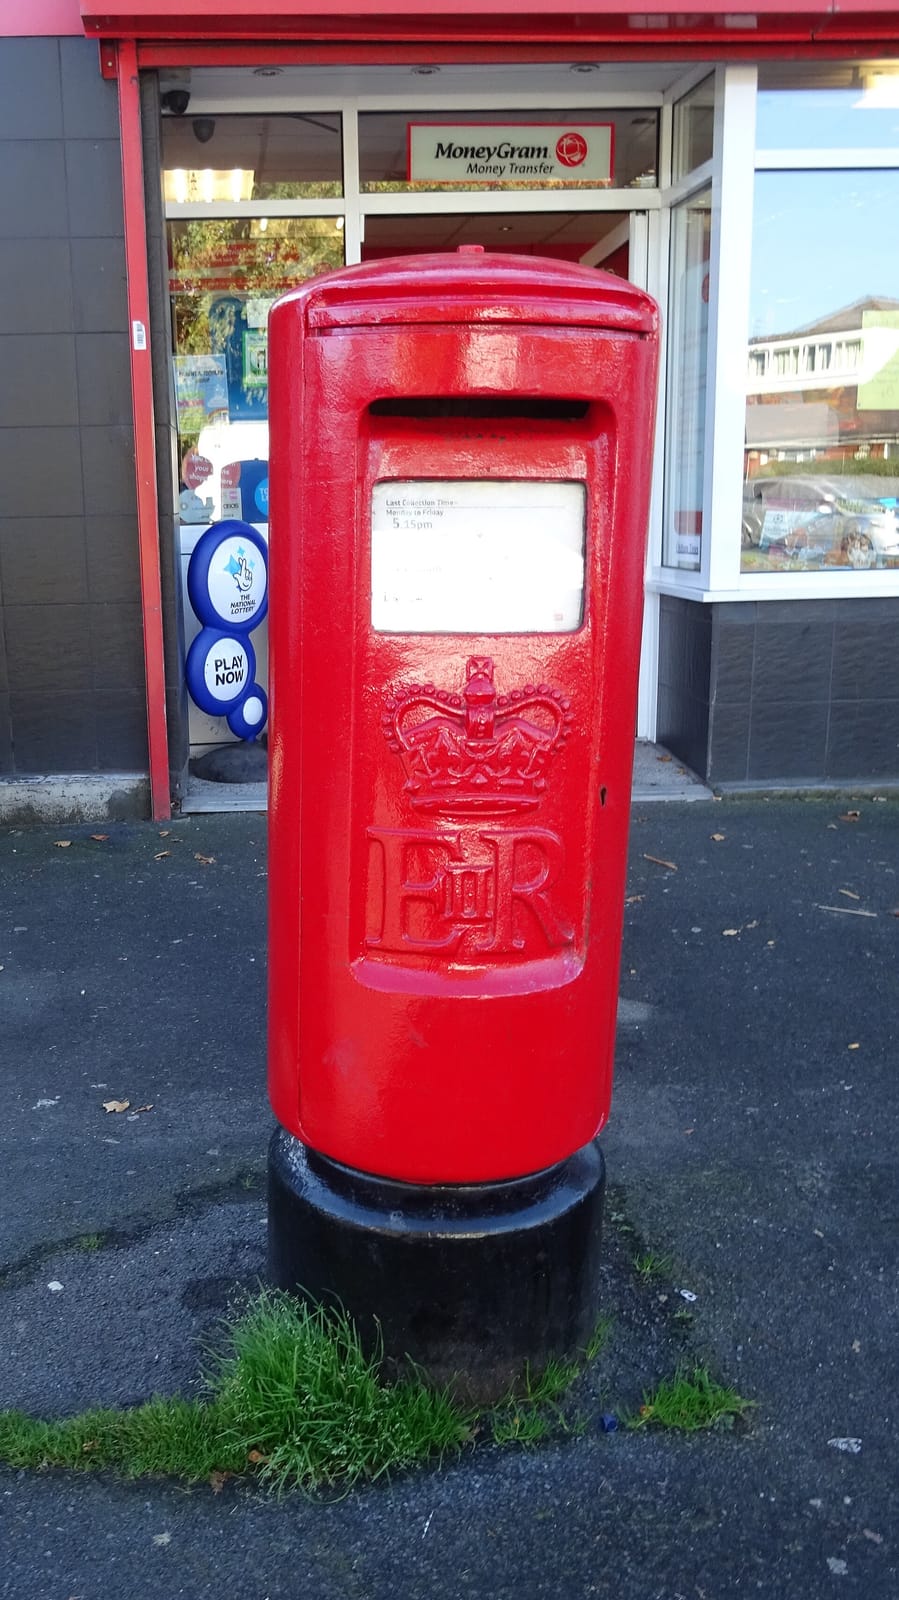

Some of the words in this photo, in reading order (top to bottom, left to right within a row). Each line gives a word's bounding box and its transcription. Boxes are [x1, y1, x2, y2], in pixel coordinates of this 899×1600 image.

[434, 142, 549, 162] MoneyGram
[466, 163, 505, 177] Money
[508, 163, 554, 175] Transfer
[423, 508, 444, 517] Friday
[230, 599, 256, 608] NATIONAL
[231, 606, 254, 614] LOTTERY
[214, 655, 243, 671] PLAY
[215, 670, 244, 687] NOW
